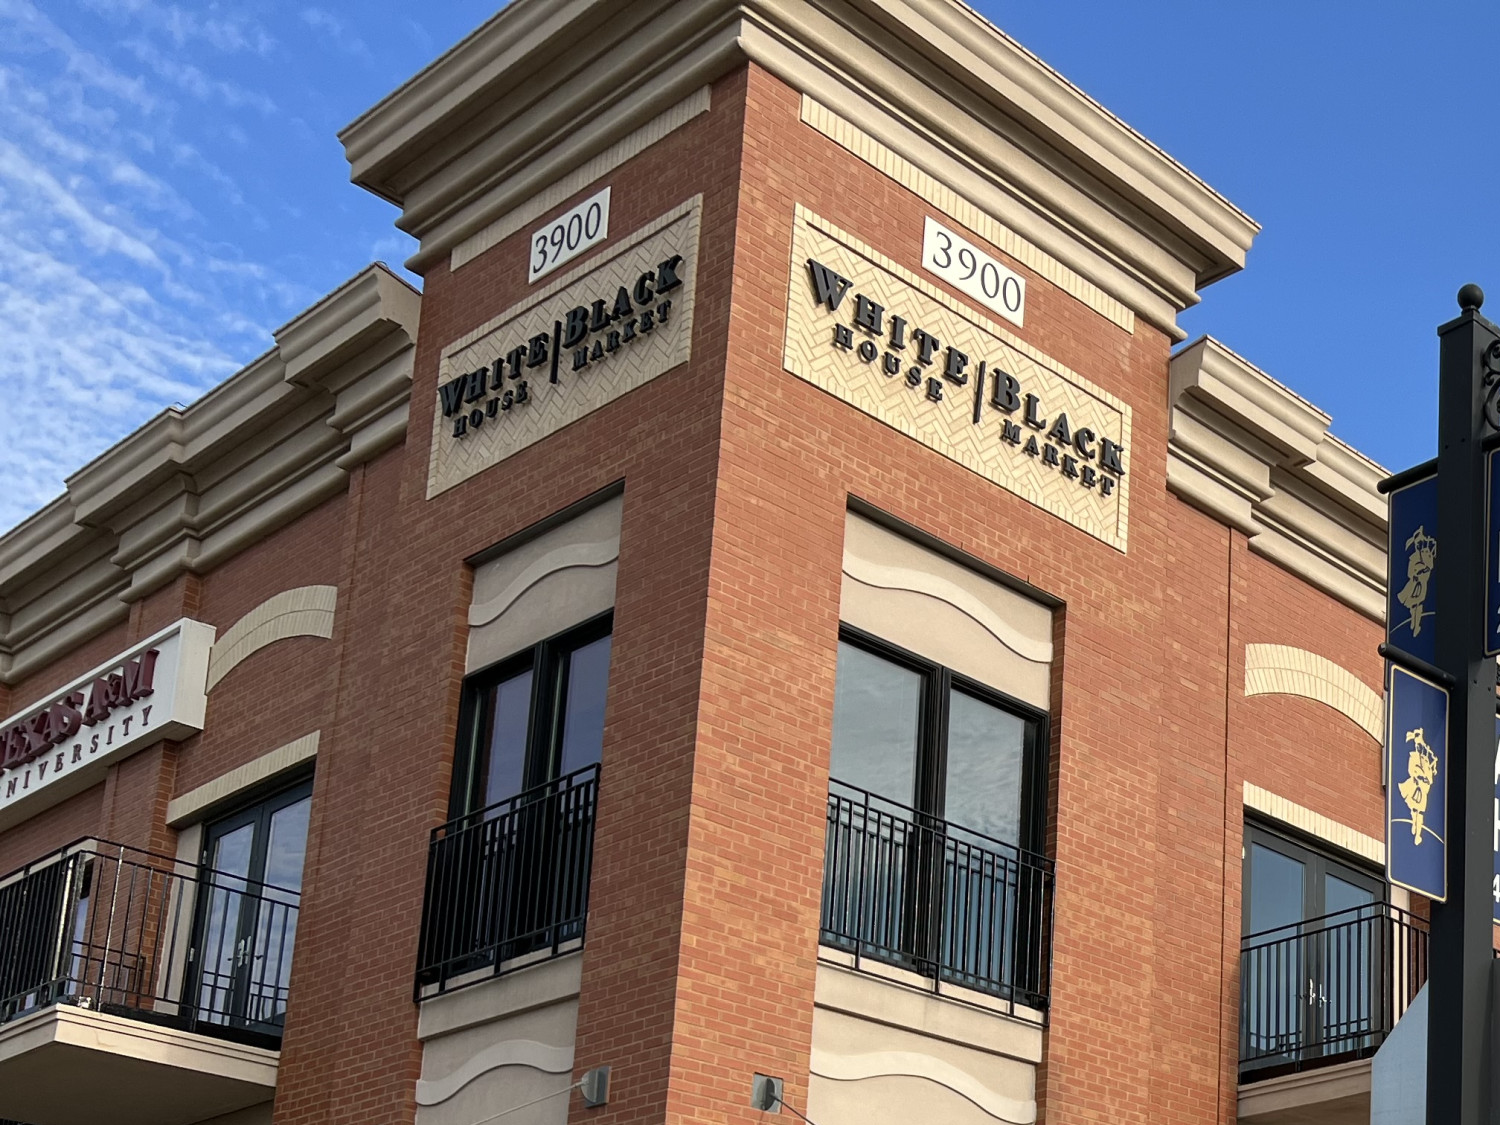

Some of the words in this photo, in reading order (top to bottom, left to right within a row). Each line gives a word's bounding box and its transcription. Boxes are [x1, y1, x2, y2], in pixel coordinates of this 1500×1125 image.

[533, 202, 602, 274] 3900
[933, 231, 1021, 312] 3900
[438, 332, 549, 417] WHITE
[563, 254, 684, 349] BLACK
[453, 381, 531, 438] HOUSE
[572, 300, 672, 371] MARKET
[807, 258, 969, 386] WHITE
[992, 368, 1125, 475] BLACK
[833, 323, 943, 402] HOUSE
[1002, 419, 1115, 496] MARKET
[0, 691, 85, 777] EXAS
[0, 704, 153, 798] NIVERSITY
